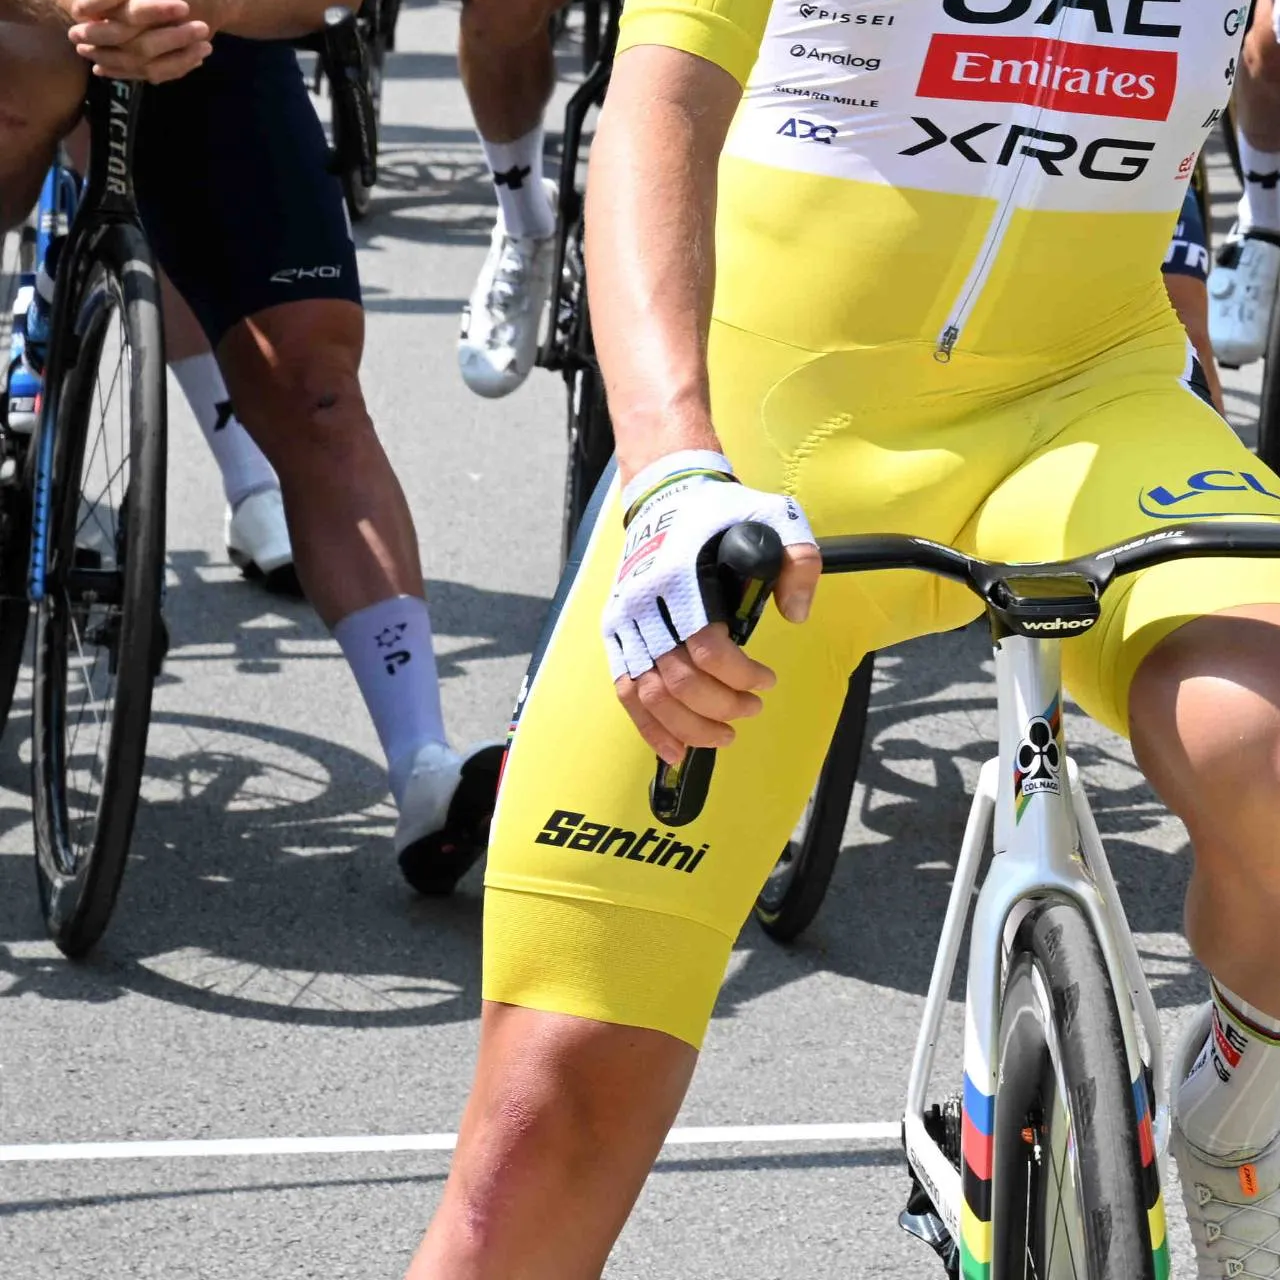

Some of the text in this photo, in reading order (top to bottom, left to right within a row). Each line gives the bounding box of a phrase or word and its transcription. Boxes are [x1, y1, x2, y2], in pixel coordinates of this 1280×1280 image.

[819, 10, 895, 27] PISSEI
[807, 46, 881, 71] Analog
[951, 50, 1156, 101] Emirates
[833, 94, 880, 109] MILLE
[107, 78, 130, 196] FACTOR
[898, 116, 1156, 182] XRG
[1021, 615, 1095, 632] wahoo
[1024, 781, 1059, 792] COLNAGO
[534, 809, 711, 874] Santini
